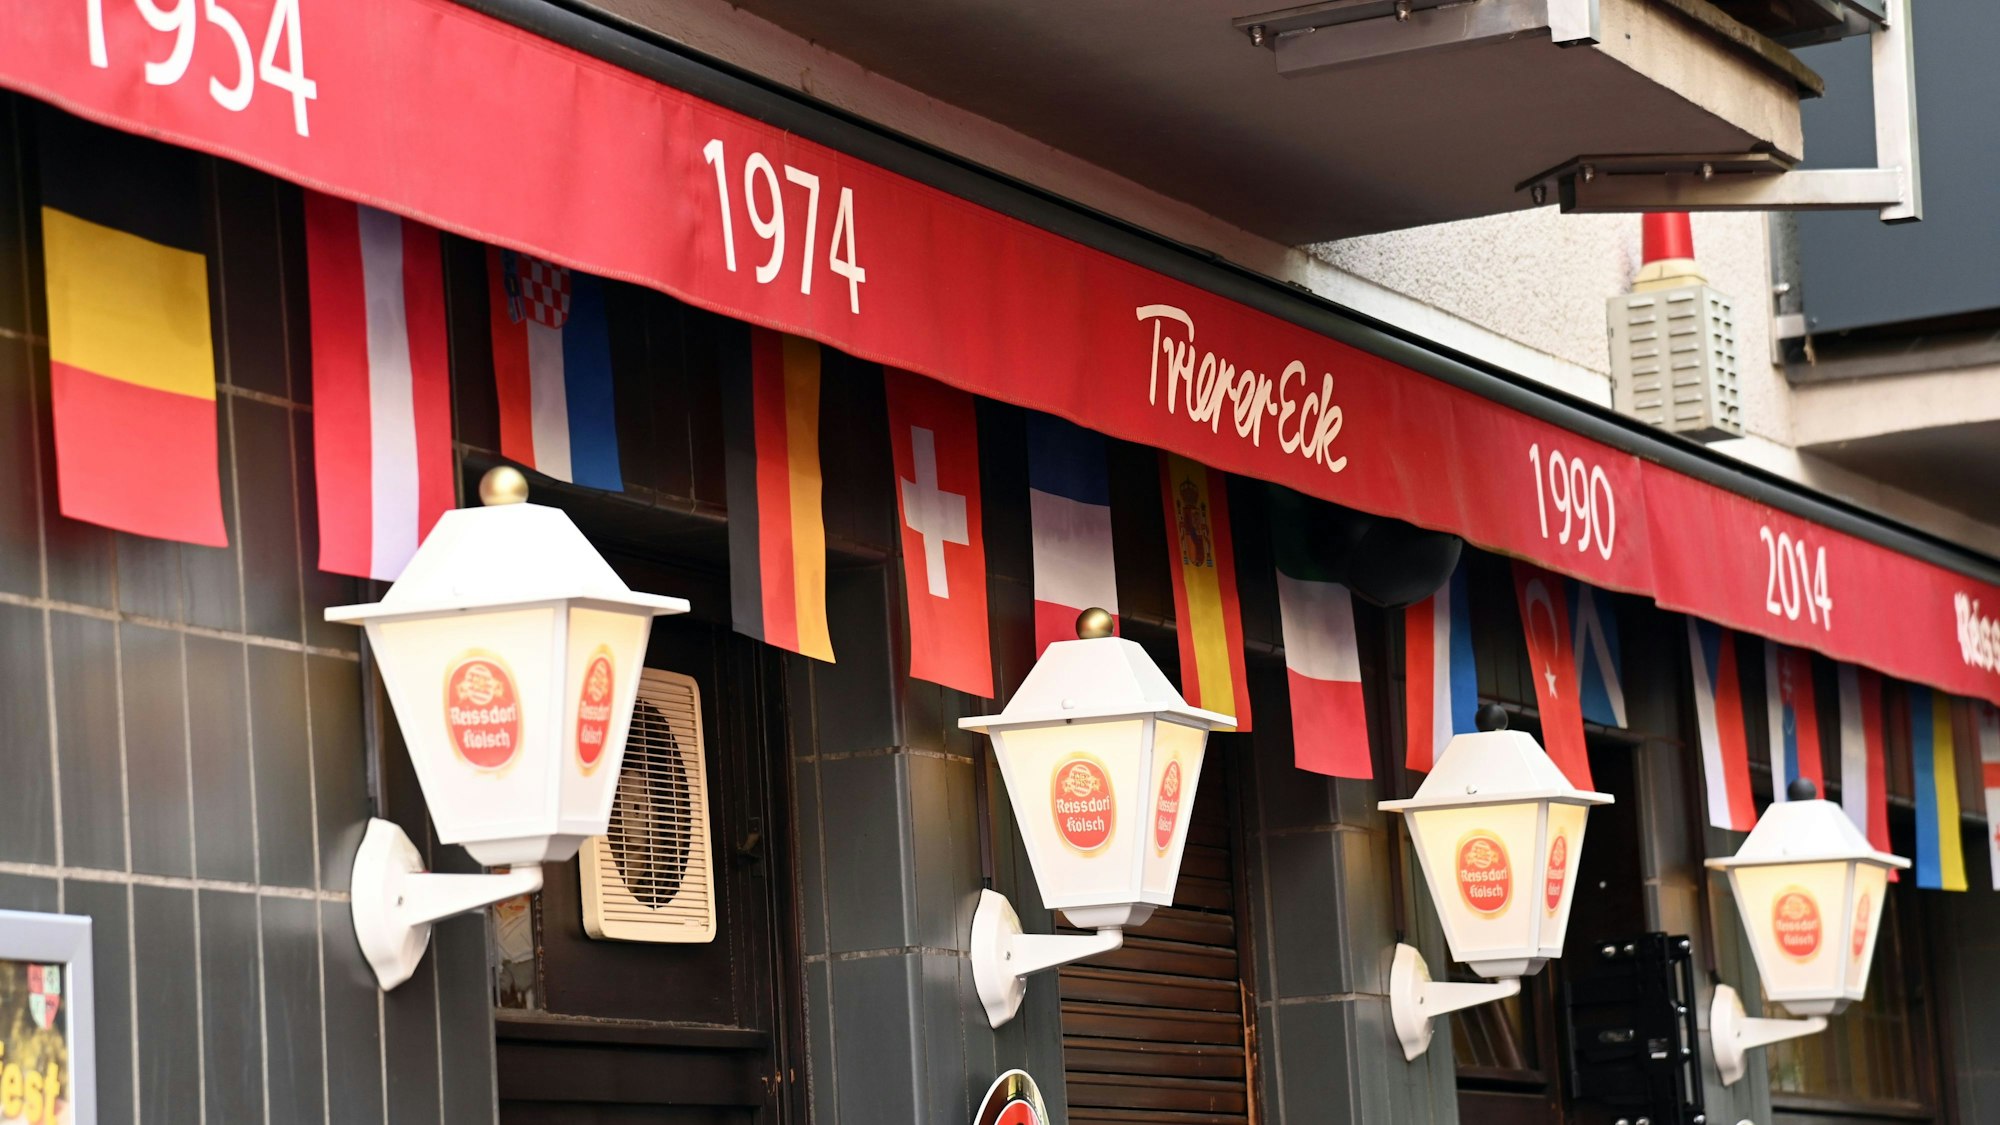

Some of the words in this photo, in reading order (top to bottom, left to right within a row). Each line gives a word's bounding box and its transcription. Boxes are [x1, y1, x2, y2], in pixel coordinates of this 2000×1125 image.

[703, 139, 866, 314] 1974
[1529, 443, 1615, 560] 1990
[1760, 525, 1832, 631] 2014
[450, 703, 517, 726] Reissdorf
[1056, 796, 1110, 814] Reissdorf
[1066, 816, 1105, 833] Kölsch
[1461, 866, 1508, 882] Reissdorf
[0, 1042, 60, 1125] est
